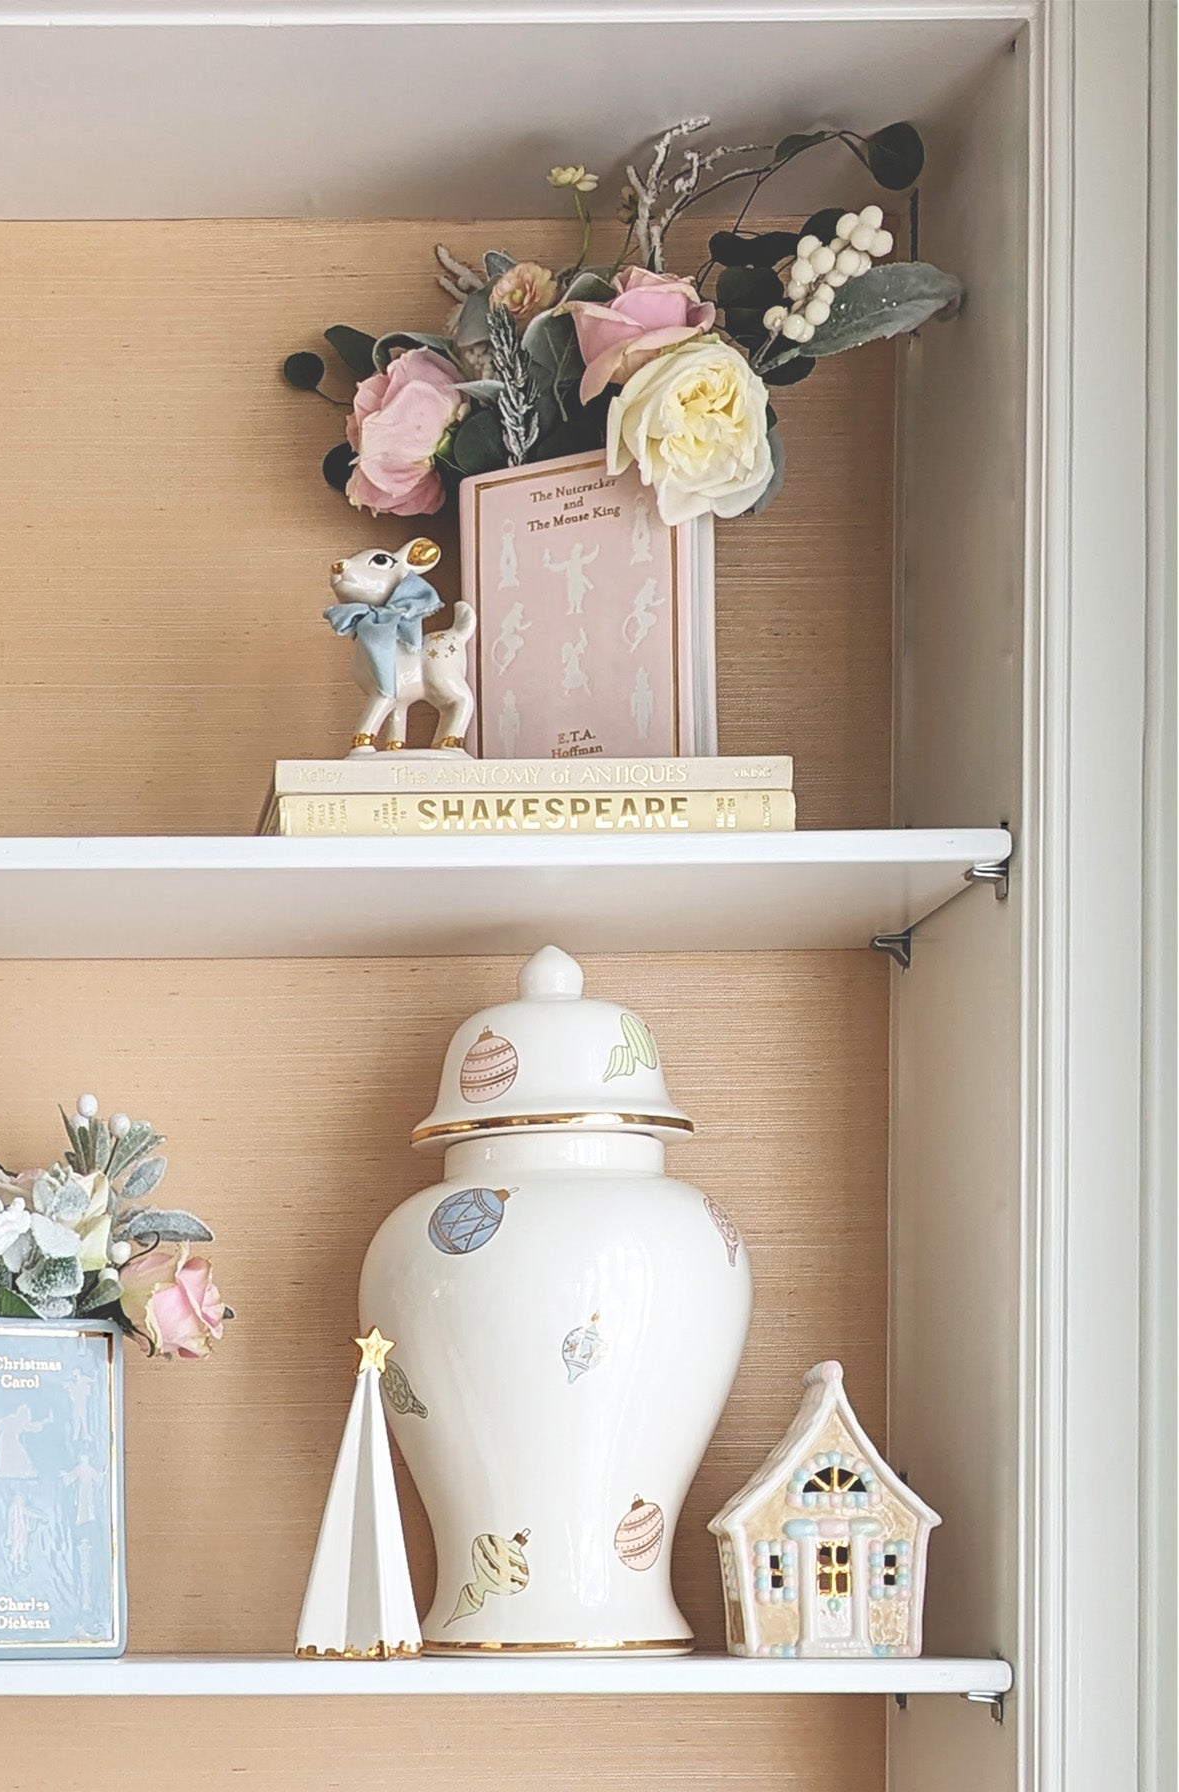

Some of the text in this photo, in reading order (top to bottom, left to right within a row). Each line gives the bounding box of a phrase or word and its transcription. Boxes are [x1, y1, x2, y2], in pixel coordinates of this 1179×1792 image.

[530, 478, 617, 503] The Nutcracker
[563, 496, 584, 510] and
[527, 506, 621, 532] The Mouse King
[558, 729, 596, 744] E.T.A.
[551, 745, 603, 758] Hoffman
[391, 766, 428, 785] The
[434, 766, 542, 785] ANATOMY
[551, 765, 571, 784] of
[580, 764, 688, 788] ANTIQUES
[417, 796, 689, 831] SHAKESPEARE
[1, 1374, 39, 1388] Carol
